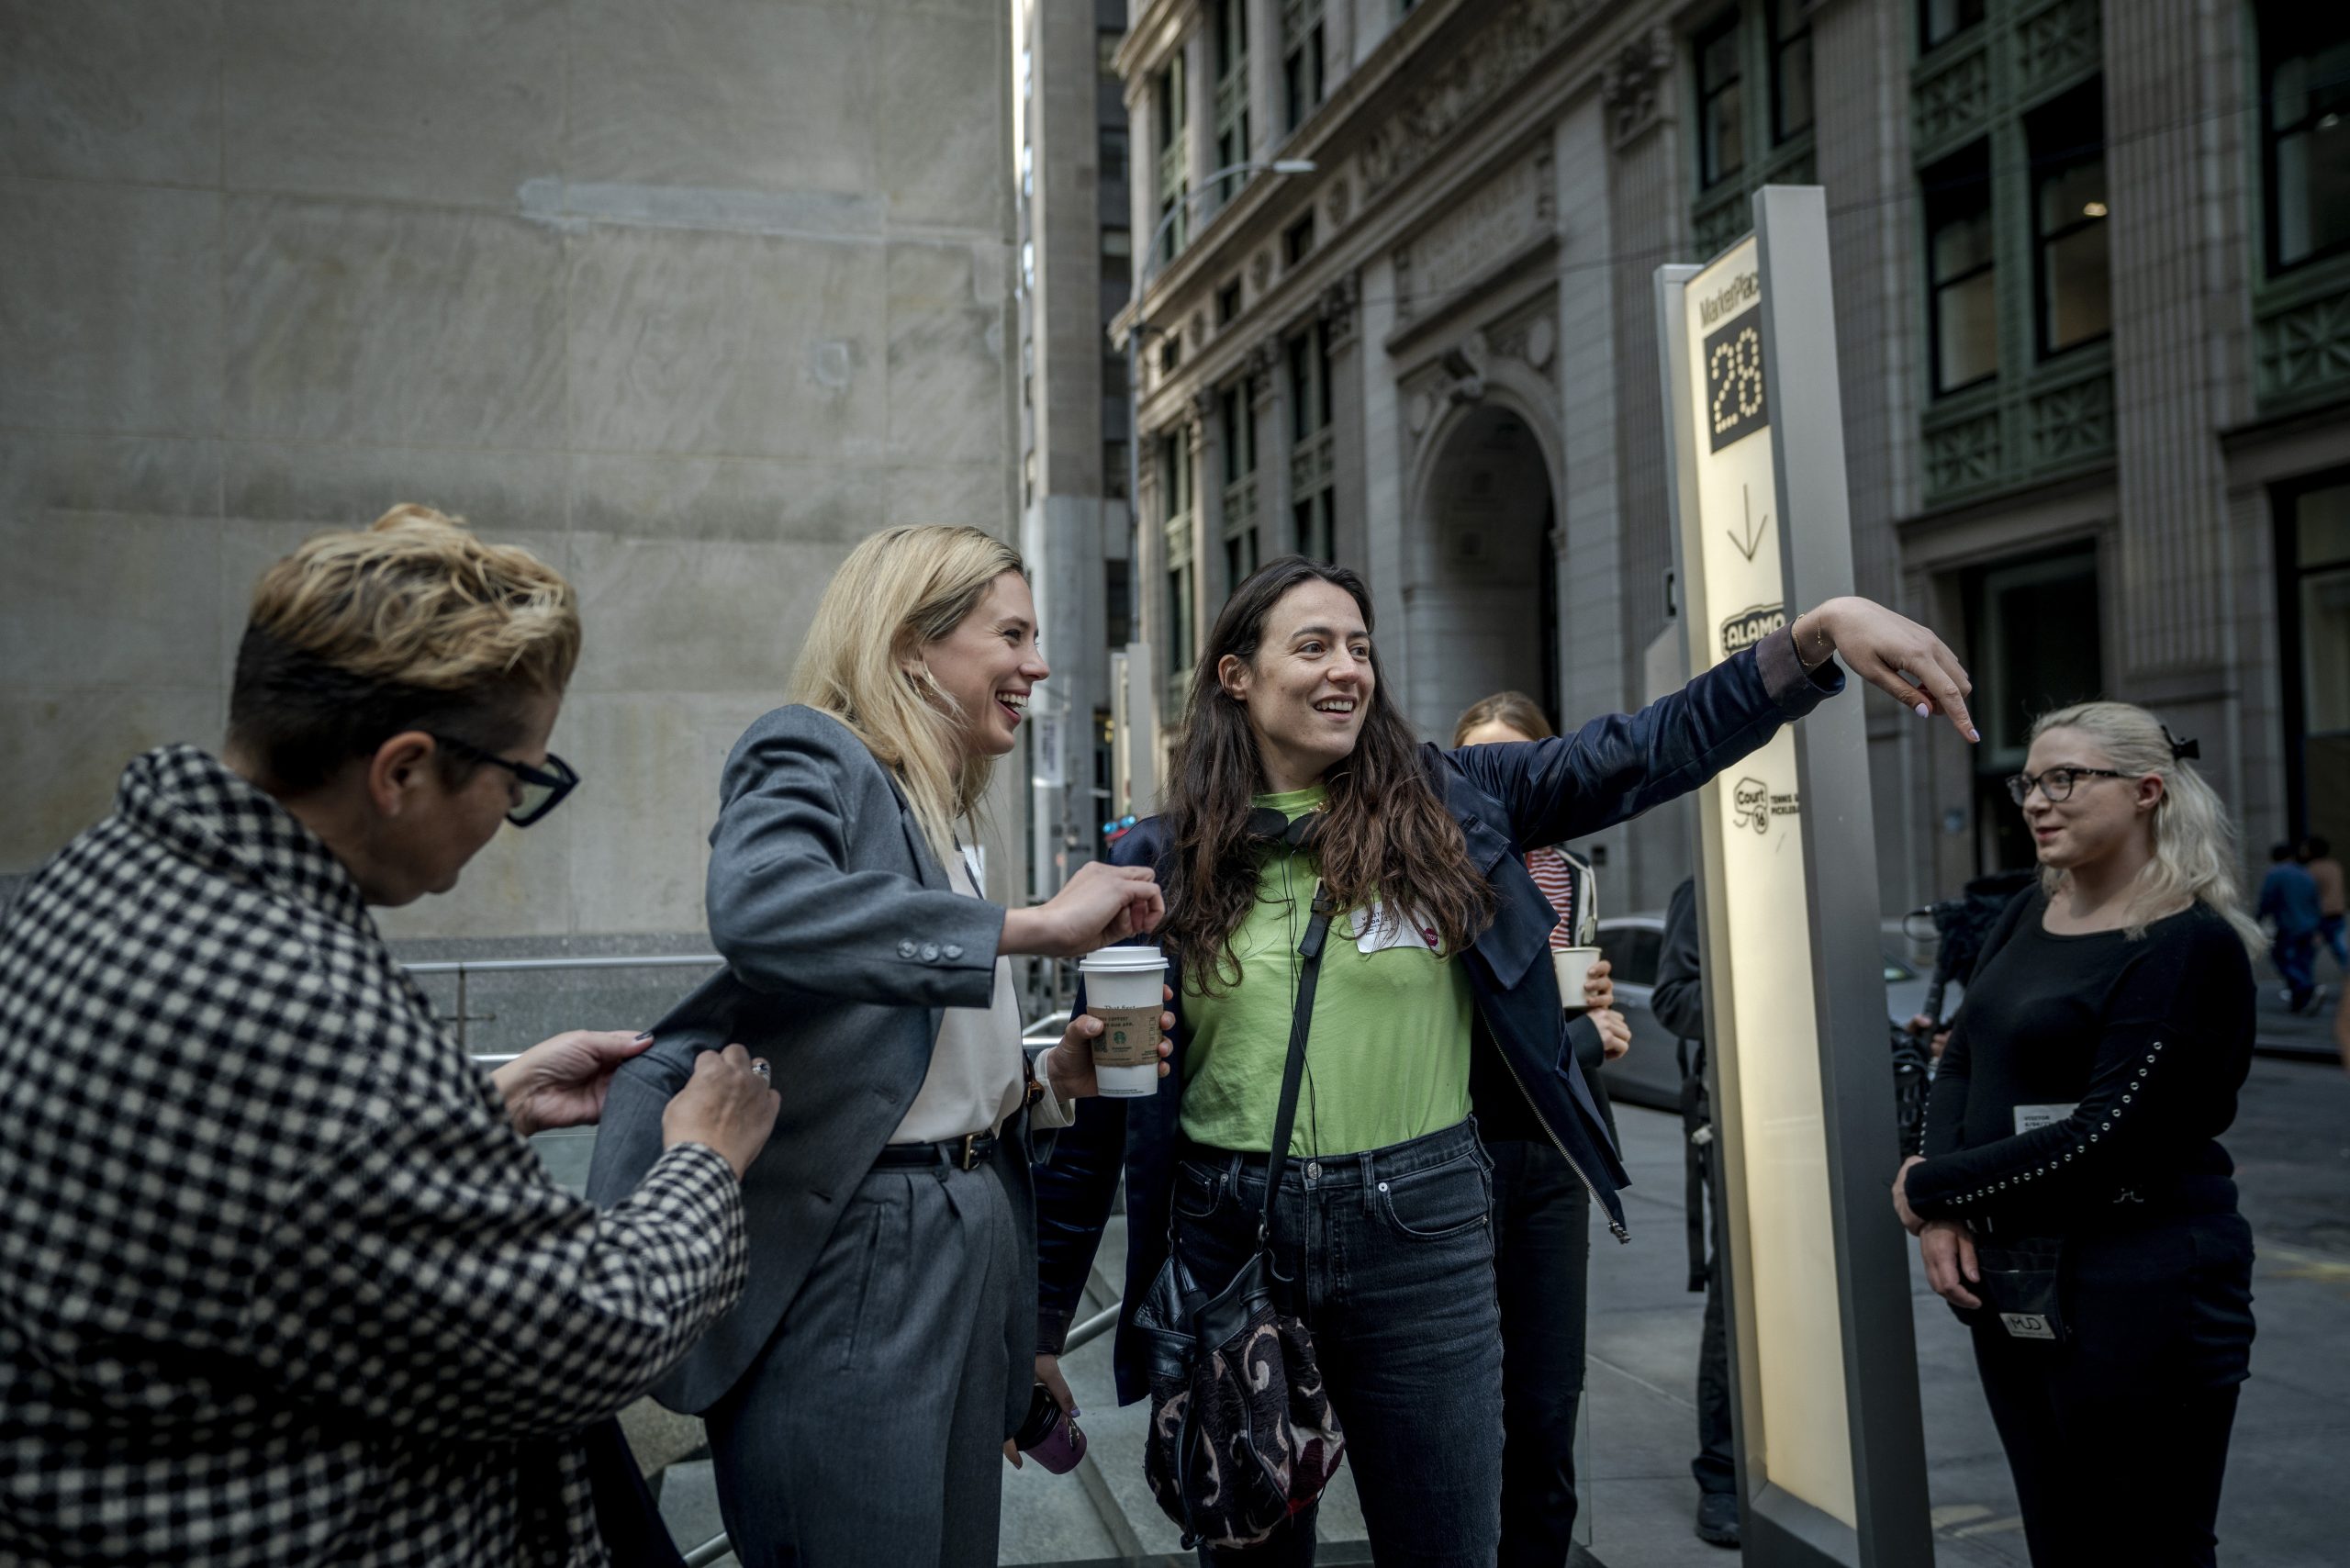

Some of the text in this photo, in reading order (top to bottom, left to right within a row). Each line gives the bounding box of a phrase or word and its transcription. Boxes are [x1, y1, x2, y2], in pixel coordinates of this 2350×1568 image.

[1711, 327, 1762, 433] 28
[1727, 612, 1785, 648] ALAMO
[1737, 789, 1764, 805] Court
[1754, 812, 1765, 826] 16
